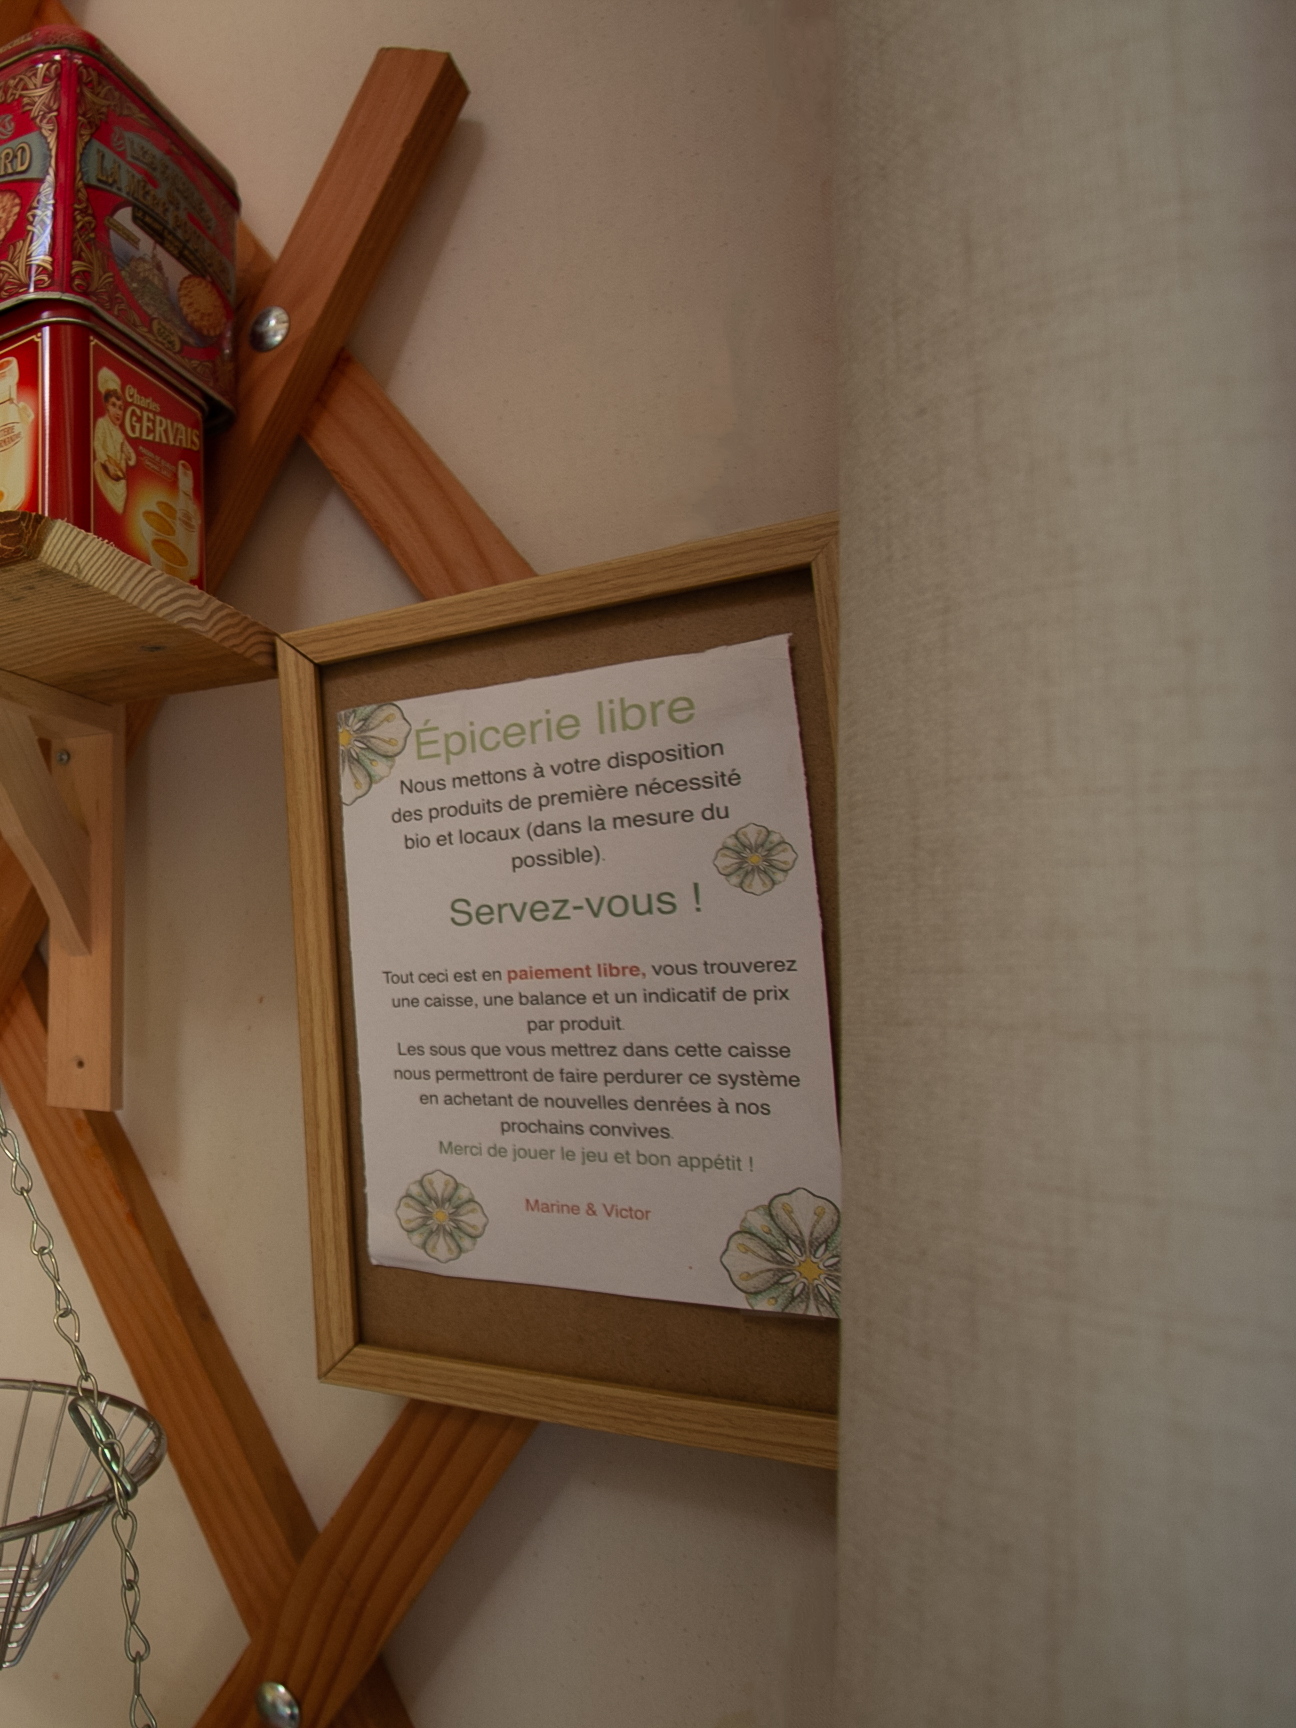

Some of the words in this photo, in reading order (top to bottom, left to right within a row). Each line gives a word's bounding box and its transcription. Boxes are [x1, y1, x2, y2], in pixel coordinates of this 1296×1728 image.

[125, 384, 161, 413] Charles
[125, 405, 200, 452] GERVAIS
[415, 709, 581, 765] Épicerie
[597, 696, 695, 735] libre
[400, 778, 447, 795] Nous
[452, 766, 527, 789] mettons
[533, 762, 545, 779] à
[550, 758, 601, 776] votre
[607, 742, 724, 769] disposition
[392, 808, 423, 823] des
[429, 798, 503, 823] produits
[508, 794, 532, 811] de
[538, 784, 628, 811] première
[635, 768, 742, 796] nécessité
[405, 833, 431, 849] bio
[437, 831, 454, 847] et
[459, 827, 521, 845] locaux
[527, 819, 582, 841] (dans
[588, 816, 606, 832] la
[613, 809, 695, 829] mesure
[701, 803, 730, 821] du
[511, 845, 606, 873] possible).
[449, 891, 678, 927] Servez-vous
[692, 882, 702, 912] !
[382, 970, 415, 985] Tout
[418, 969, 449, 984] ceci
[453, 969, 478, 983] est
[482, 970, 503, 981] en
[507, 964, 592, 983] paiement
[597, 963, 647, 979] libre,
[651, 963, 698, 977] vous
[703, 959, 798, 975] trouverez
[392, 996, 420, 1008] une
[424, 994, 479, 1009] caisse,
[483, 994, 514, 1007] une
[519, 991, 587, 1006] balance
[592, 990, 610, 1004] et
[615, 991, 638, 1004] un
[643, 986, 717, 1003] indicatif
[722, 986, 747, 1002] de
[753, 985, 791, 1005] prix
[527, 1018, 555, 1034] par
[560, 1015, 625, 1034] produit.
[397, 1042, 425, 1056] Les
[429, 1044, 466, 1056] sous
[470, 1044, 502, 1060] que
[506, 1044, 546, 1057] vous
[551, 1043, 618, 1057] mettrez
[623, 1042, 669, 1057] dans
[674, 1043, 722, 1058] cette
[727, 1042, 791, 1058] caisse
[394, 1069, 431, 1081] nous
[435, 1068, 529, 1084] permettront
[533, 1068, 554, 1082] de
[560, 1068, 598, 1084] faire
[603, 1069, 683, 1087] perdurer
[688, 1072, 712, 1085] ce
[717, 1070, 801, 1090] système
[419, 1093, 439, 1105] en
[444, 1092, 513, 1107] achetant
[518, 1093, 539, 1108] de
[544, 1095, 629, 1111] nouvelles
[634, 1096, 712, 1113] denrées
[717, 1098, 730, 1114] à
[735, 1101, 771, 1115] nos
[500, 1119, 585, 1136] prochains
[589, 1122, 674, 1139] convives.
[439, 1141, 483, 1157] Merci
[487, 1144, 508, 1158] de
[512, 1144, 556, 1162] jouer
[561, 1146, 576, 1161] le
[581, 1147, 608, 1165] jeu
[613, 1149, 632, 1164] et
[636, 1149, 671, 1166] bon
[677, 1154, 743, 1173] appétit
[748, 1155, 754, 1172] !
[524, 1198, 581, 1215] Marine
[585, 1202, 598, 1216] &
[603, 1203, 652, 1221] Victor
